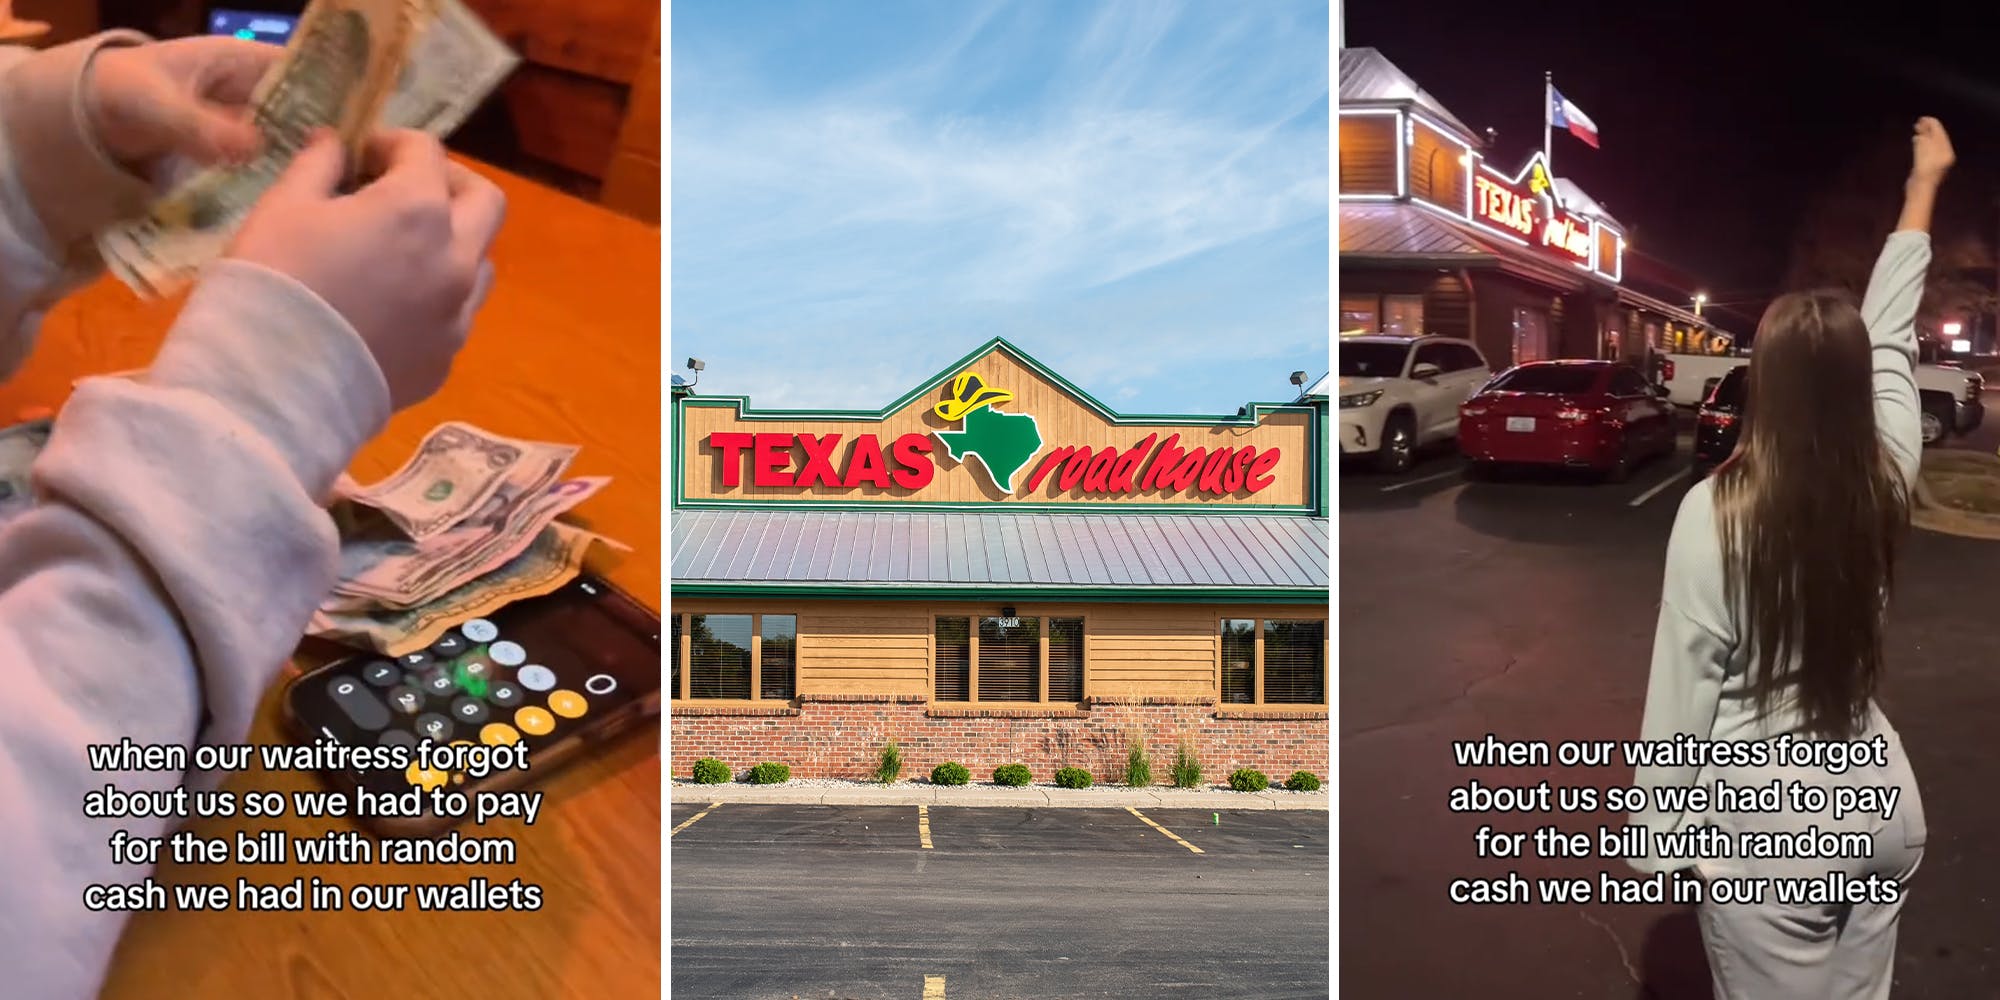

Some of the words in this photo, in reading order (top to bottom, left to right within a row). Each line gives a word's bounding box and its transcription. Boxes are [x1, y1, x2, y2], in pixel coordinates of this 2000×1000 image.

[710, 432, 935, 490] TEXAS
[998, 616, 1020, 627] 3910
[585, 674, 617, 696] 0
